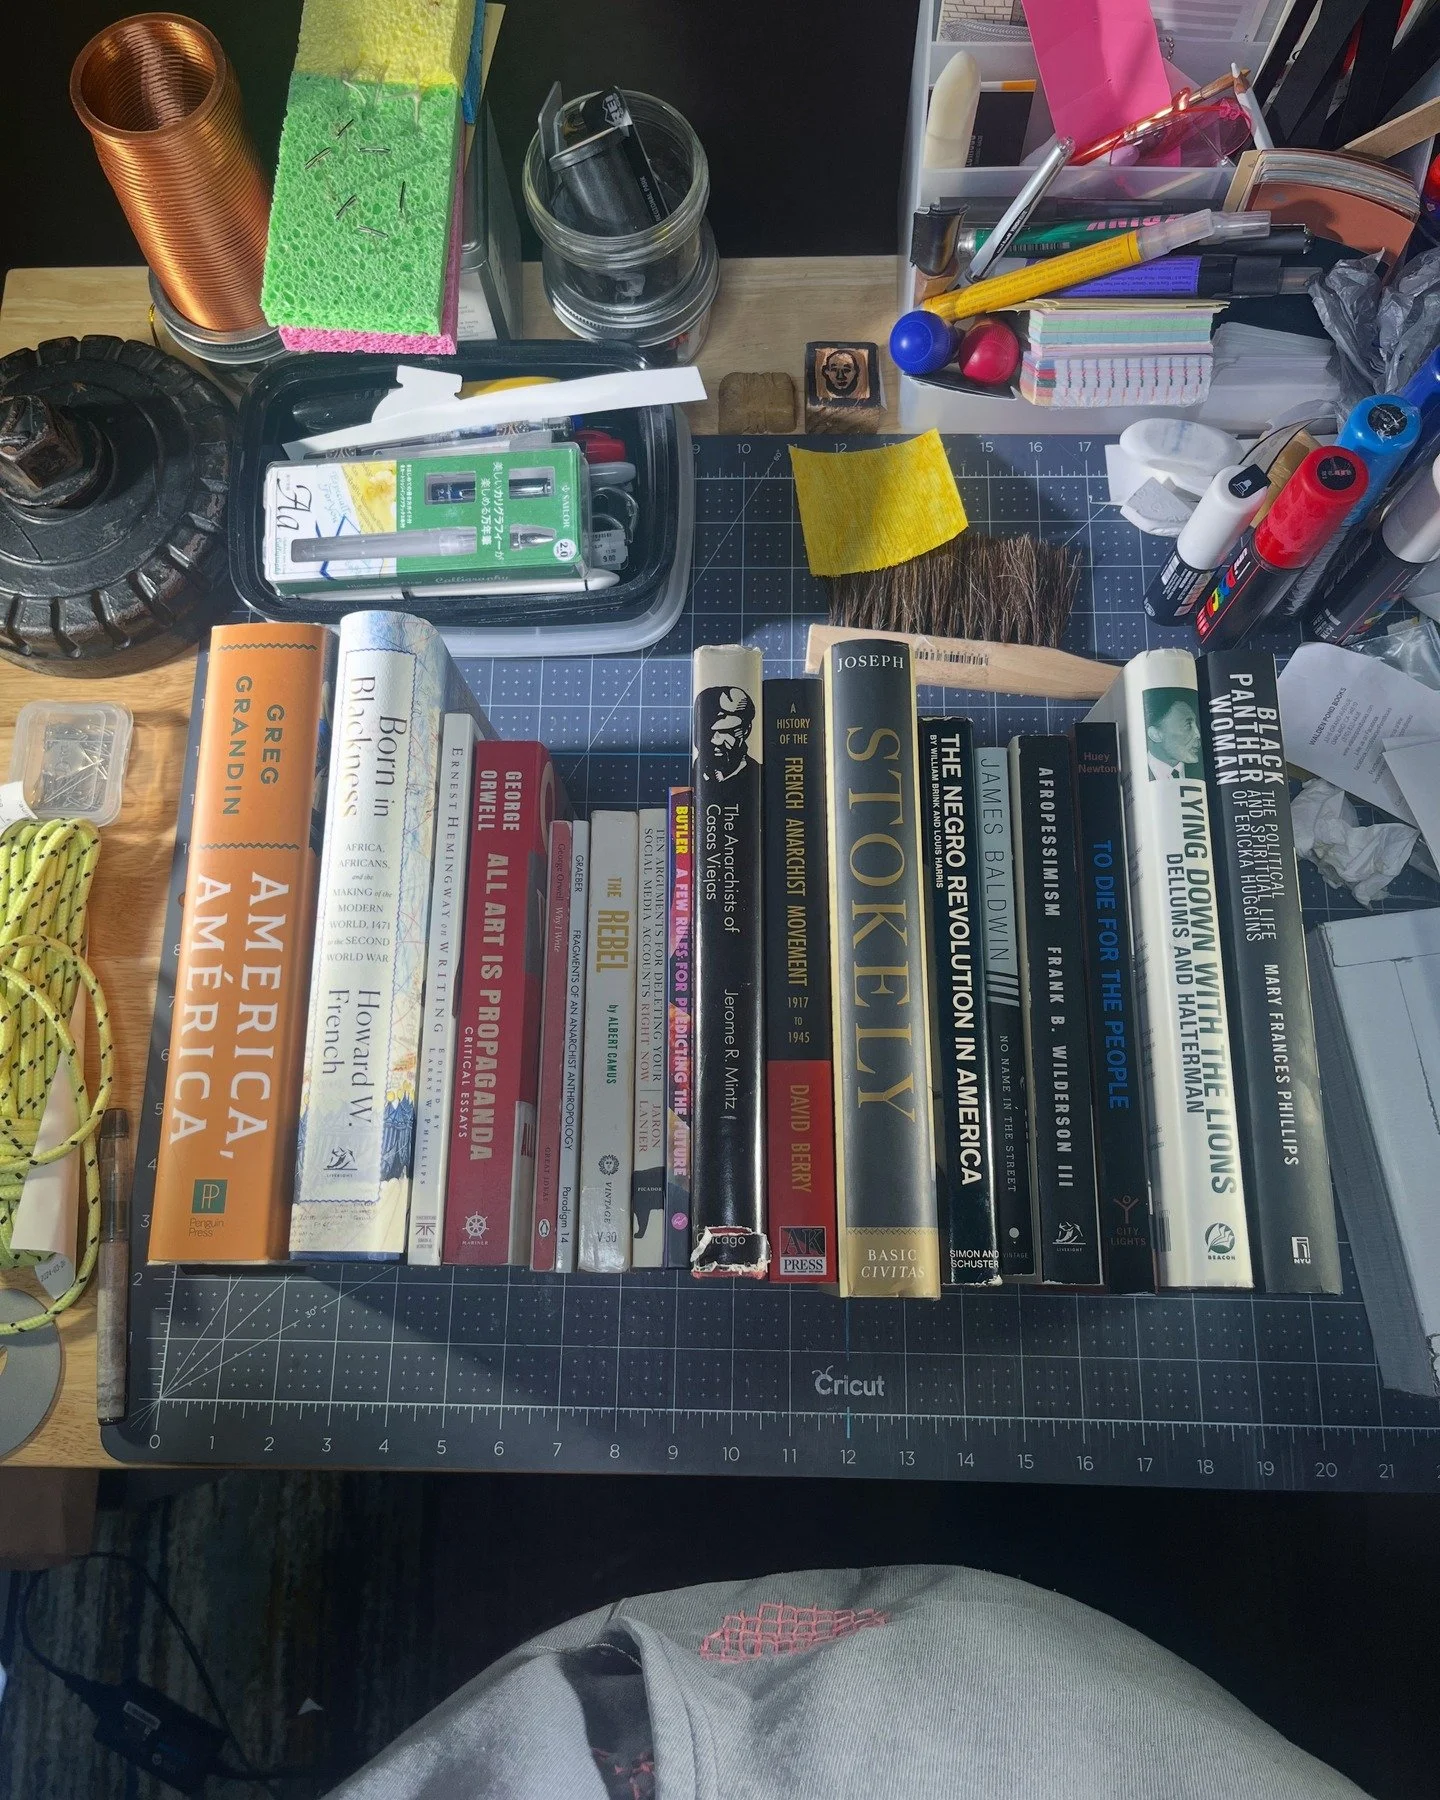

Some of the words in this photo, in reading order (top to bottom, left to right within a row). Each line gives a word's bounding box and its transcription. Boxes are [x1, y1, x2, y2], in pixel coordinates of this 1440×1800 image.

[277, 484, 314, 531] Aa
[492, 462, 504, 562] 美しいカリグラフィーが
[560, 497, 570, 530] SAILOR
[837, 654, 904, 673] JOSEPH
[776, 718, 810, 730] HISTORY
[1229, 673, 1263, 783] PANTHER
[1308, 721, 1326, 746] WALDEN
[1322, 705, 1335, 722] POND
[1331, 685, 1346, 706] BOOKS
[222, 675, 252, 815] GRANDIN
[260, 704, 285, 785] GREG
[342, 676, 377, 818] Blackness
[376, 715, 407, 786] Born
[792, 734, 808, 745] THE
[941, 733, 962, 778] THE
[1083, 751, 1110, 763] Huey
[1208, 694, 1239, 786] WOMAN
[1256, 706, 1285, 786] BLACK
[447, 746, 464, 813] ERNEST
[785, 757, 804, 809] FRENCH
[931, 746, 939, 783] WILLIAM
[1078, 763, 1118, 774] Newton
[373, 798, 396, 817] in
[478, 770, 498, 831] ORWELL
[502, 771, 522, 831] GEORGE
[724, 803, 740, 831] The
[932, 783, 940, 808] BRINK
[980, 758, 1003, 836] JAMES
[1231, 790, 1248, 808] OF
[1246, 789, 1263, 819] AND
[1259, 789, 1277, 818] THE
[656, 829, 665, 852] TEN
[675, 805, 689, 855] BUTLER
[705, 803, 721, 853] Casas
[933, 810, 941, 828] AND
[934, 829, 942, 854] LOUIS
[943, 785, 966, 868] NEGRO
[1038, 766, 1061, 917] AFROPESSIMISM
[1179, 785, 1209, 859] LYING
[339, 858, 391, 869] AFRICANS,
[345, 843, 386, 854] AFRICA,
[643, 828, 653, 875] SOCIAL
[786, 817, 806, 896] ANARCHIST
[1093, 839, 1113, 869] TO
[1234, 814, 1254, 871] ERICKA
[1250, 824, 1272, 901] SPIRITUAL
[1263, 823, 1285, 900] POLITICAL
[440, 816, 459, 920] HEMINGWAY
[485, 853, 509, 894] ALL
[574, 854, 584, 893] GRAEBER
[607, 877, 622, 898] THE
[702, 854, 721, 901] Viejas
[723, 834, 740, 912] Anarchists
[935, 855, 944, 889] HARRIS
[332, 887, 373, 898] MAKING
[337, 903, 384, 914] MODERN
[642, 880, 652, 921] MEDIA
[654, 859, 665, 937] ARGUMENTS
[675, 883, 689, 911] FEW
[984, 850, 1010, 961] BALDWIN
[1095, 876, 1116, 910] DIE
[1166, 853, 1189, 938] DELLUMS
[1186, 868, 1216, 952] DOWN
[1239, 874, 1262, 942] HUGGINS
[344, 936, 391, 947] SECOND
[482, 902, 507, 946] ART
[595, 910, 630, 973] REBEL
[786, 905, 807, 987] MOVEMENT
[846, 727, 915, 1122] STOKELY
[1097, 918, 1119, 961] FOR
[1258, 907, 1277, 941] LIFE
[325, 953, 364, 963] WORLD
[365, 953, 389, 964] WAR
[480, 954, 503, 980] IS
[570, 930, 582, 983] FRAGMENTS
[641, 927, 652, 998] ACCOUNTS
[654, 941, 664, 968] FOR
[946, 875, 975, 1029] REVOLUTION
[1173, 945, 1193, 986] AND
[433, 940, 449, 1033] WRITING
[1047, 946, 1065, 1004] FRANK
[1100, 969, 1122, 1012] THE
[1263, 964, 1284, 1007] MARY
[169, 873, 234, 1145] AMÉRICA
[220, 871, 290, 1159] AMERICA,
[653, 972, 663, 1043] DELETING
[723, 989, 739, 1045] Jerome
[787, 997, 809, 1009] 1917
[1193, 962, 1223, 1035] WITH
[322, 989, 350, 1076] French
[350, 990, 381, 1087] Howard
[567, 1016, 579, 1070] ANARCHIST
[607, 1016, 619, 1050] ALBERT
[640, 1002, 650, 1046] RIGHT
[673, 997, 688, 1083] PREDICTING
[788, 1031, 810, 1044] 1945
[999, 1034, 1009, 1052] NO
[460, 1026, 474, 1086] CRITICAL
[606, 1052, 618, 1084] CAMUS
[640, 1051, 650, 1083] NOW
[652, 1046, 662, 1082] YOUR
[724, 1048, 740, 1063] R.
[954, 1037, 976, 1061] IN
[1104, 1019, 1129, 1109] PEOPLE
[1177, 993, 1205, 1113] HALTERMAN
[1267, 1012, 1290, 1085] FRANCES
[470, 988, 502, 1161] PROPAGANDA
[724, 1066, 740, 1110] Mintz
[1000, 1057, 1011, 1093] NAME
[1200, 1045, 1228, 1098] THE
[458, 1092, 469, 1139] ESSAYS
[564, 1071, 577, 1151] ANTHROPOLOGY
[673, 1090, 687, 1116] THE
[789, 1084, 811, 1133] DAVID
[1052, 1044, 1072, 1152] WILDERSON
[639, 1100, 649, 1153] LANIER
[651, 1103, 662, 1148] JARON
[672, 1120, 687, 1176] FUTURE
[956, 1067, 982, 1186] AMERICA
[1003, 1115, 1013, 1139] THE
[1276, 1090, 1300, 1166] PHILLIPS
[791, 1143, 812, 1193] BERRY
[1004, 1144, 1016, 1192] STREET
[1206, 1108, 1237, 1194] LIONS
[1057, 1165, 1074, 1187] III
[189, 1217, 225, 1230] Penguin
[559, 1186, 572, 1228] Paradigm
[188, 1227, 213, 1238] Press
[697, 1232, 746, 1247] Cicago
[782, 1227, 825, 1256] AK
[867, 1249, 916, 1261] BASIC
[949, 1249, 981, 1259] SIMON
[982, 1249, 1000, 1258] AND
[783, 1258, 823, 1271] PRESS
[861, 1265, 925, 1279] CIVITAS
[950, 1259, 999, 1268] SCHUSTER
[1293, 1257, 1312, 1265] NYU
[304, 1304, 319, 1320] 30°
[814, 1367, 885, 1398] Cricut
[723, 1446, 740, 1462] 10
[840, 1448, 857, 1464] 12
[1316, 1461, 1338, 1477] 20
